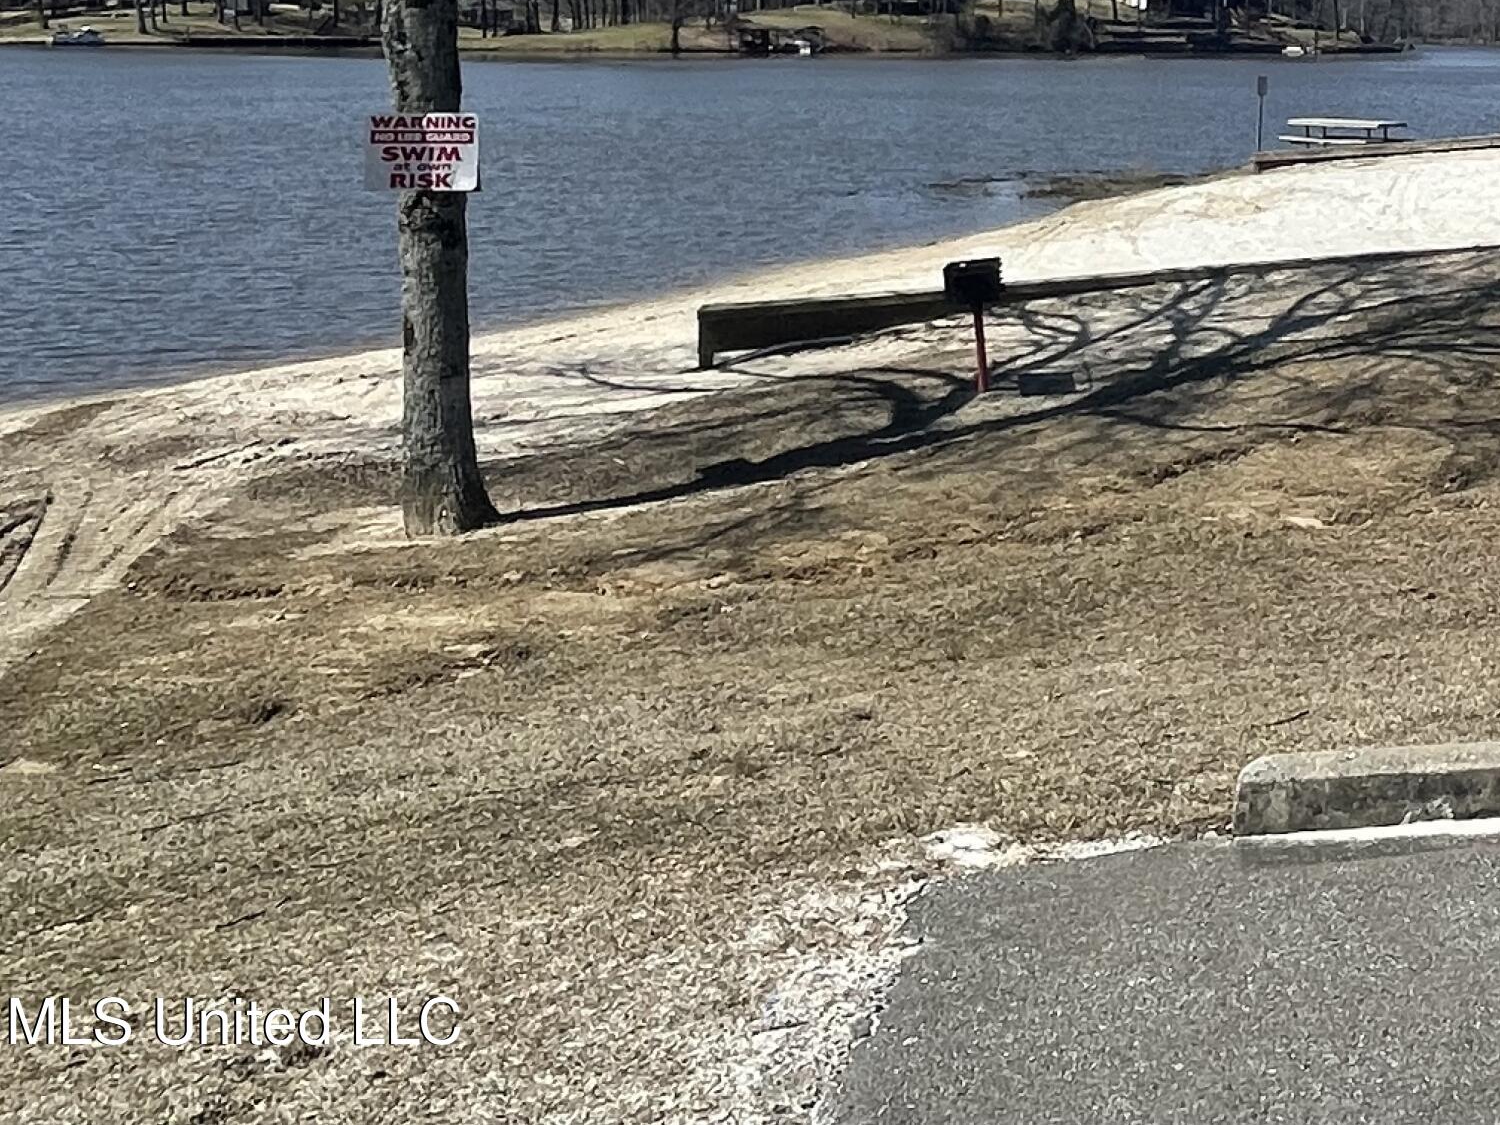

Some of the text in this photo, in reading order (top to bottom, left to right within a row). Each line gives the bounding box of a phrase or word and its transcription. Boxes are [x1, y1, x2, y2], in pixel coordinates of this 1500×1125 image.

[371, 116, 476, 129] WARNING
[381, 146, 462, 162] SWIM
[417, 163, 451, 171] own
[390, 173, 452, 189] RISK
